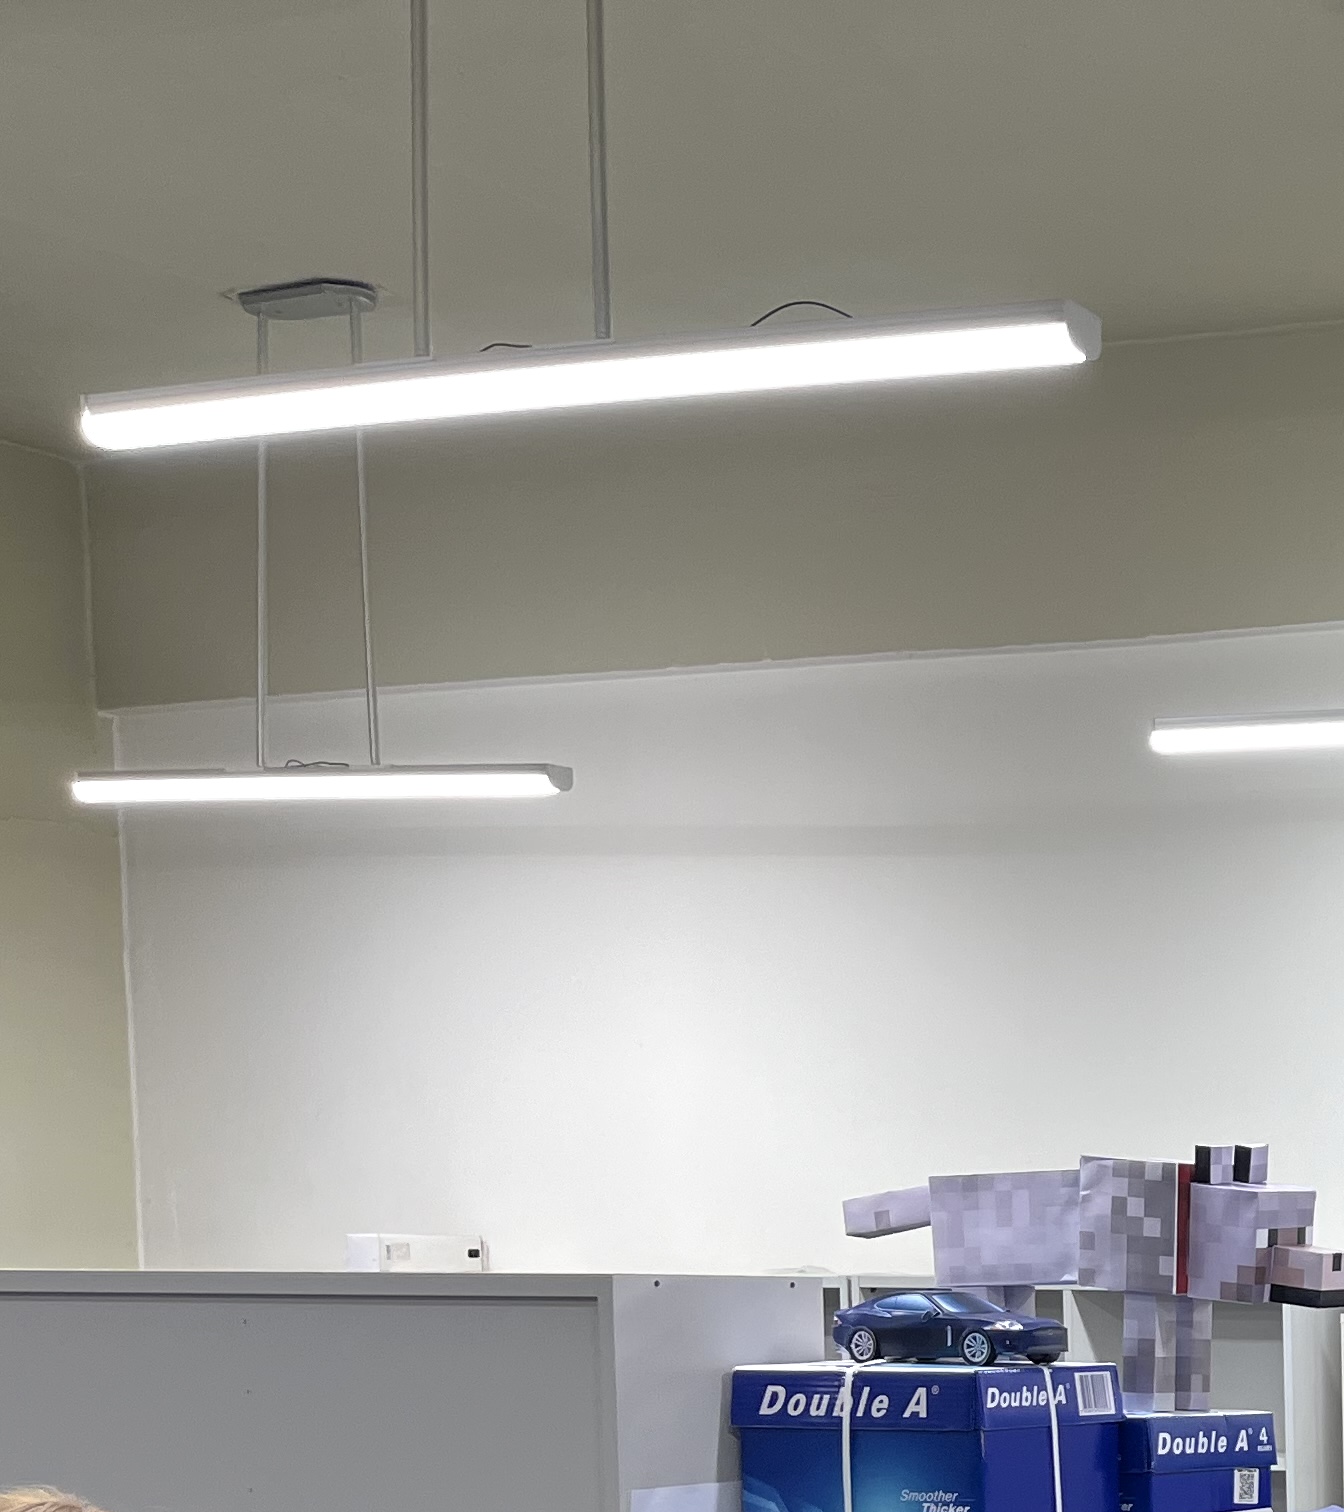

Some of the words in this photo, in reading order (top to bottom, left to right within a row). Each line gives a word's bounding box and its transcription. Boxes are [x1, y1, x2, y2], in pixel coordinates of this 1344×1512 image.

[759, 1383, 889, 1419] Double
[986, 1385, 1048, 1410] Double
[1157, 1429, 1228, 1456] Double
[1259, 1426, 1269, 1445] 4
[901, 1489, 959, 1502] Smoother
